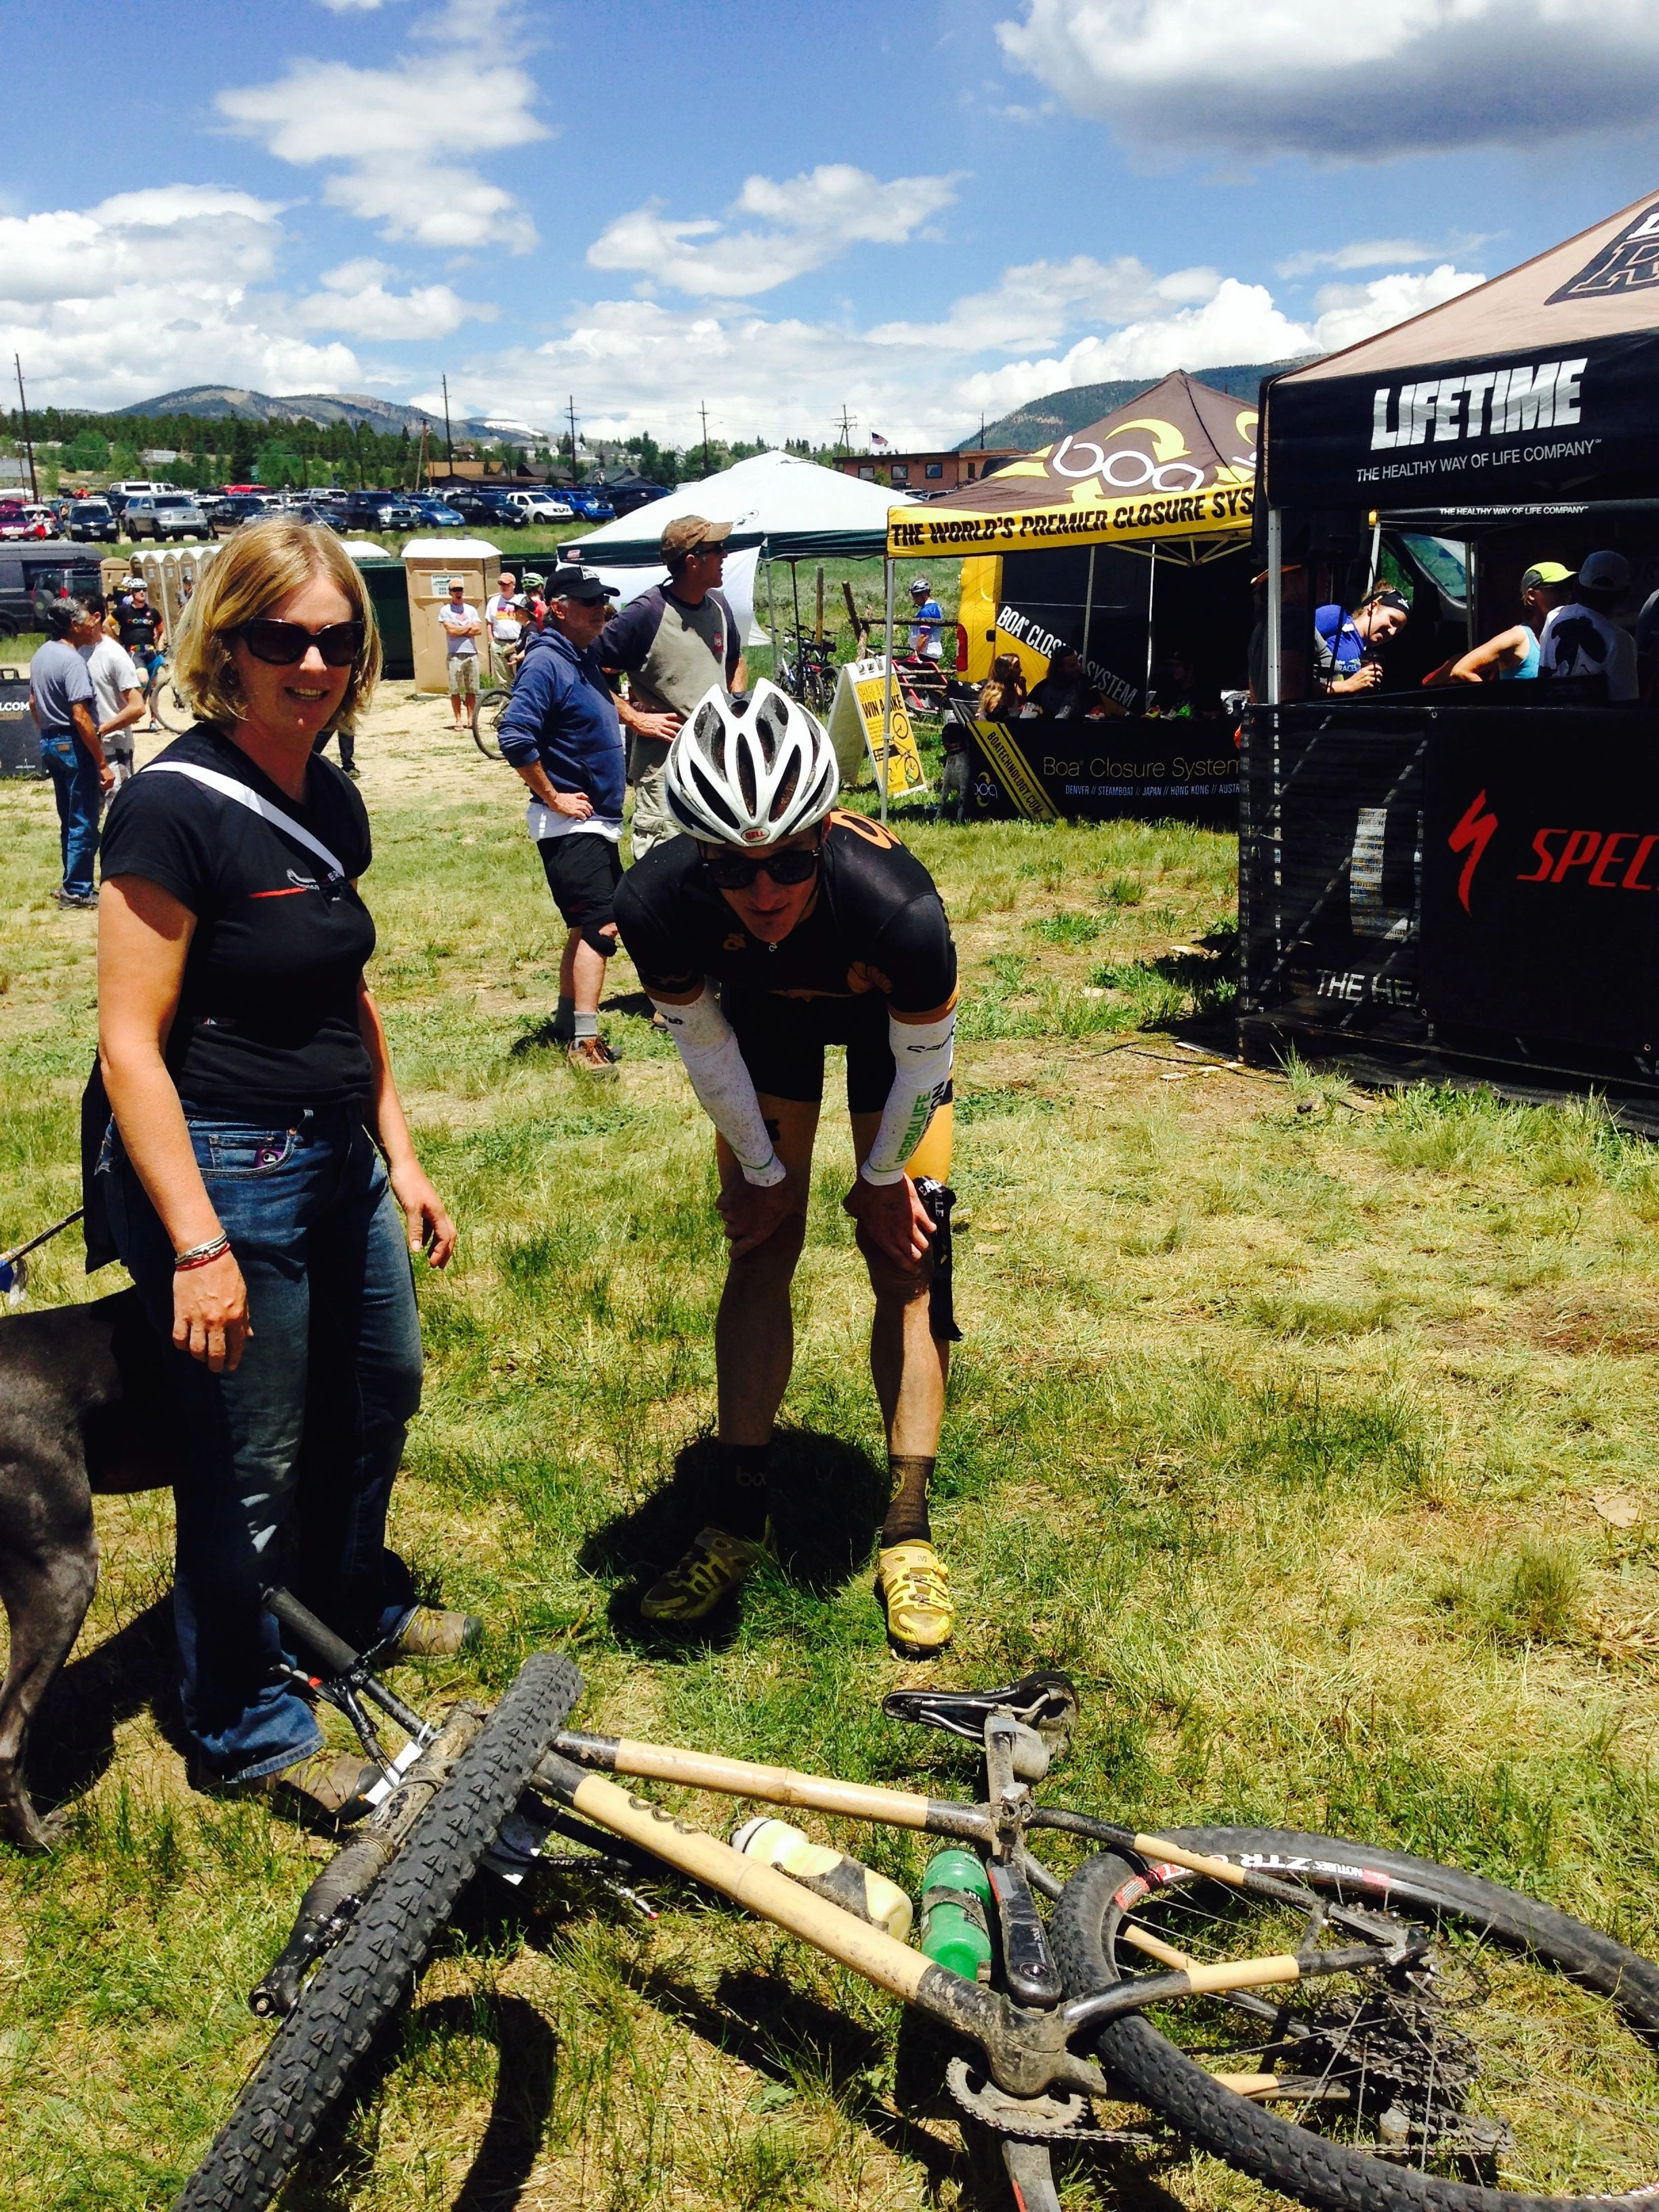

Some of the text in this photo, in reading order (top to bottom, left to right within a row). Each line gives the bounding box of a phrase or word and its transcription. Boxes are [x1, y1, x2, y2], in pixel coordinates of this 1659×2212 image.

[1370, 358, 1588, 450] LIFETIME
[1357, 467, 1380, 483] THE
[1382, 460, 1438, 479] HEALTHY
[1440, 455, 1468, 472] WAY
[1471, 453, 1490, 469] OF
[1492, 449, 1520, 466] LIFE
[891, 487, 1254, 546] THE WORLD'S PREMIER CLOSURE SYS
[1493, 507, 1511, 515] WAY
[1512, 507, 1524, 515] OF
[1525, 506, 1542, 514] LIFE
[1086, 660, 1138, 708] SYSTEM
[861, 699, 880, 718] WIN
[987, 732, 1043, 815] BOATECHNOLOGY.COM
[1090, 758, 1166, 777] Closure
[1065, 785, 1089, 795] DENVER
[1098, 785, 1134, 796] STEAMBOAT
[1142, 786, 1162, 796] JAPAN
[1171, 785, 1189, 796] HONG
[1191, 785, 1209, 795] KONG
[1219, 783, 1240, 794] AUSTR
[745, 830, 767, 840] BELL
[1517, 828, 1659, 890] SPEC
[1317, 969, 1365, 1002] THE
[895, 1090, 931, 1163] HERBALIFE
[1240, 1853, 1313, 1872] ZTR
